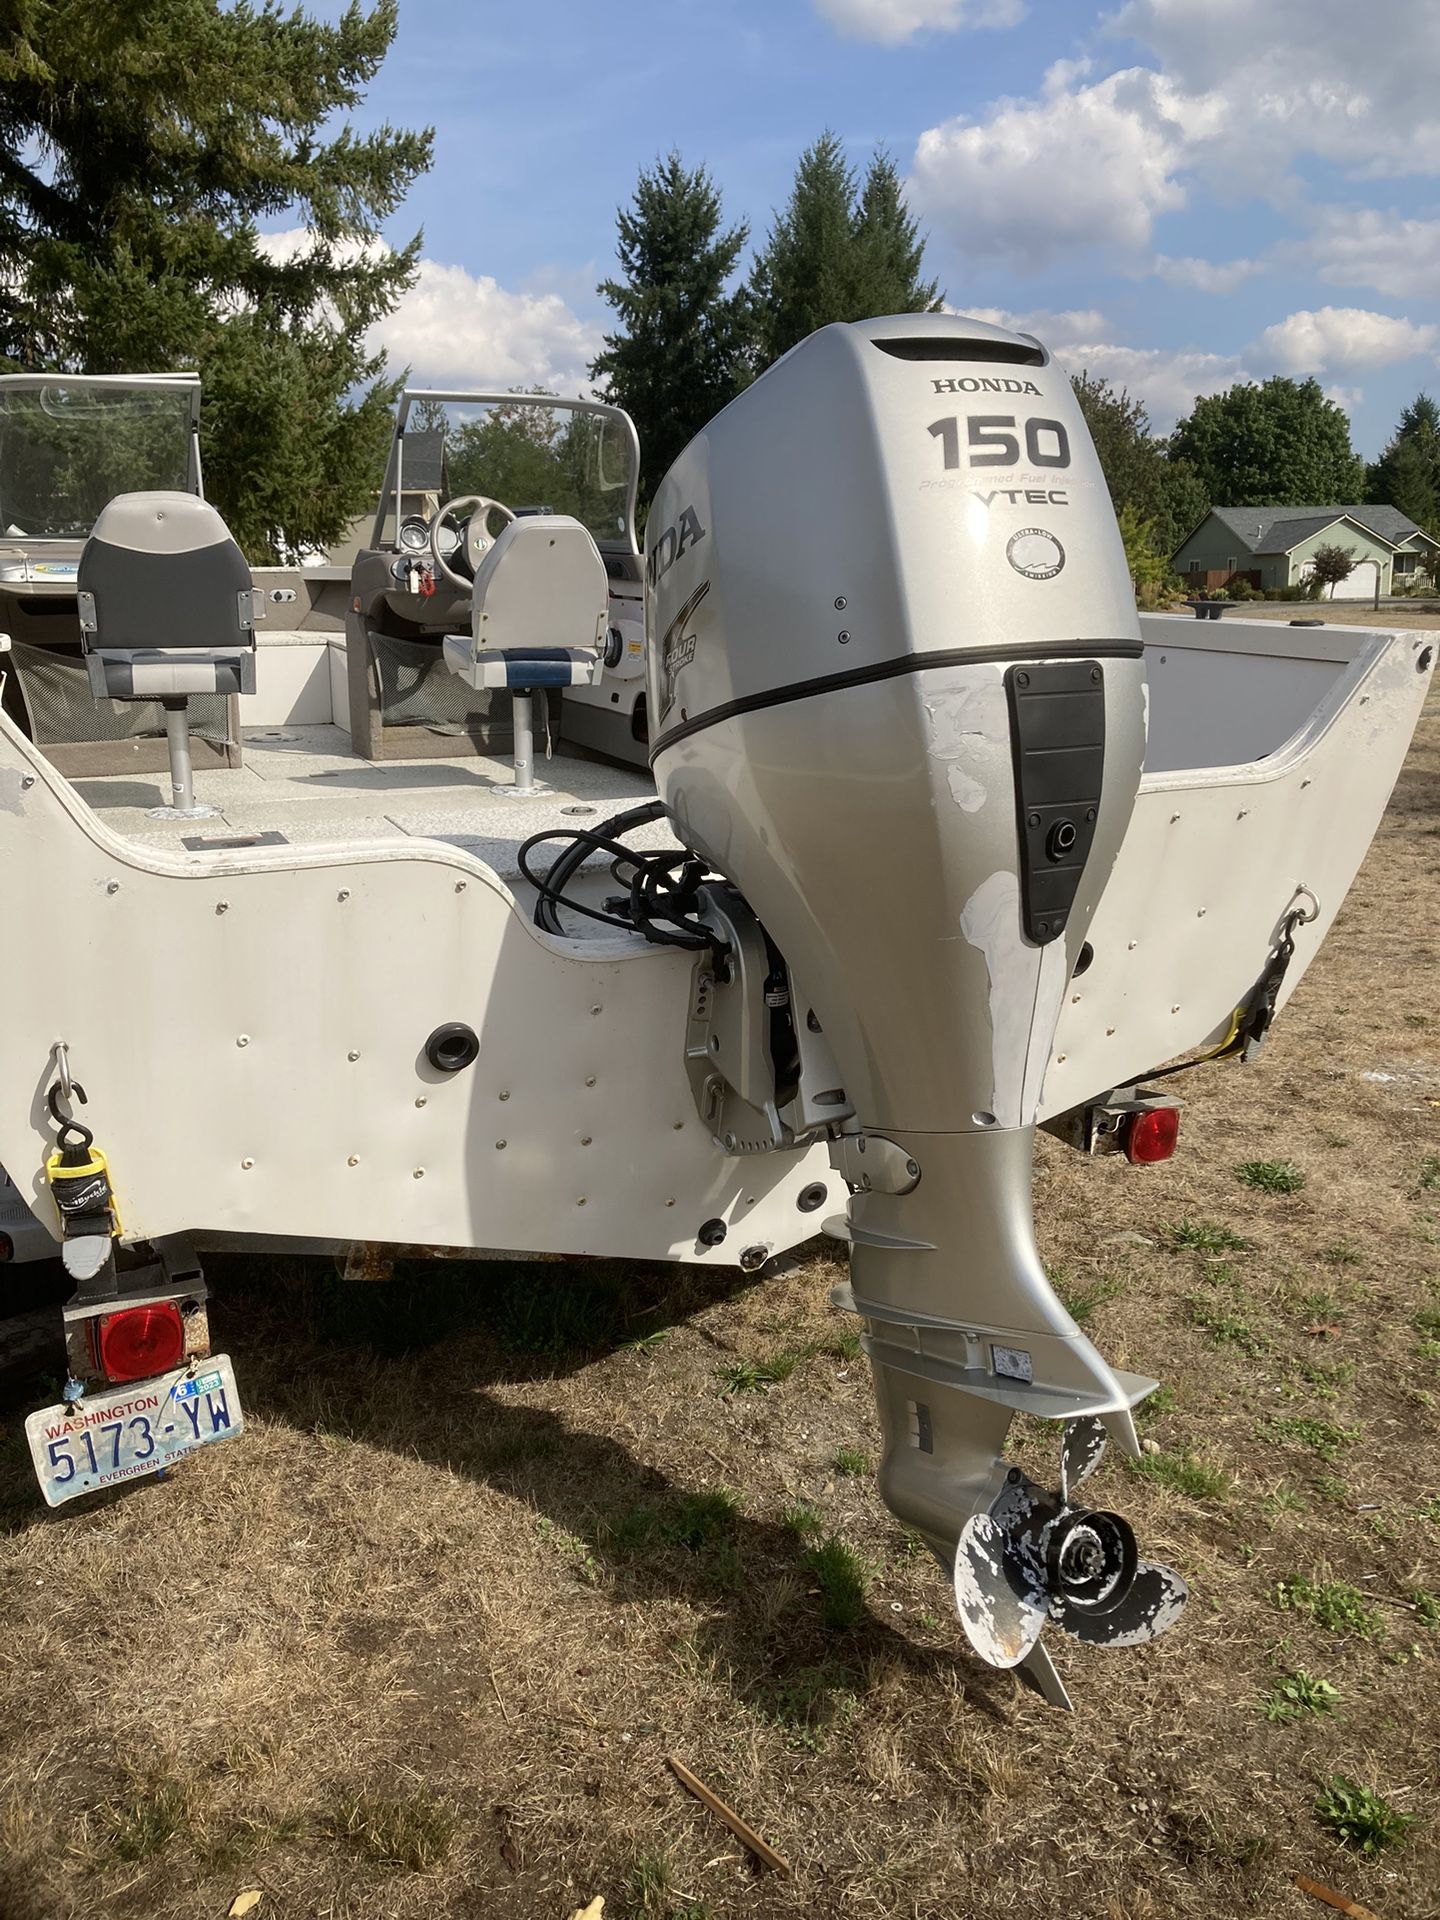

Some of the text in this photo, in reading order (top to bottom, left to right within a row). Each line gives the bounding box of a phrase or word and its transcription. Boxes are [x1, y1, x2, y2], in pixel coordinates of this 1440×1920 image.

[931, 378, 1043, 396] HONDA
[927, 416, 1071, 470] 150
[971, 490, 1069, 508] VTEC
[665, 637, 696, 667] FOUR
[198, 1380, 220, 1393] 2023
[44, 1395, 159, 1440] WASHINGTON
[99, 1458, 160, 1484] EVERGREEN
